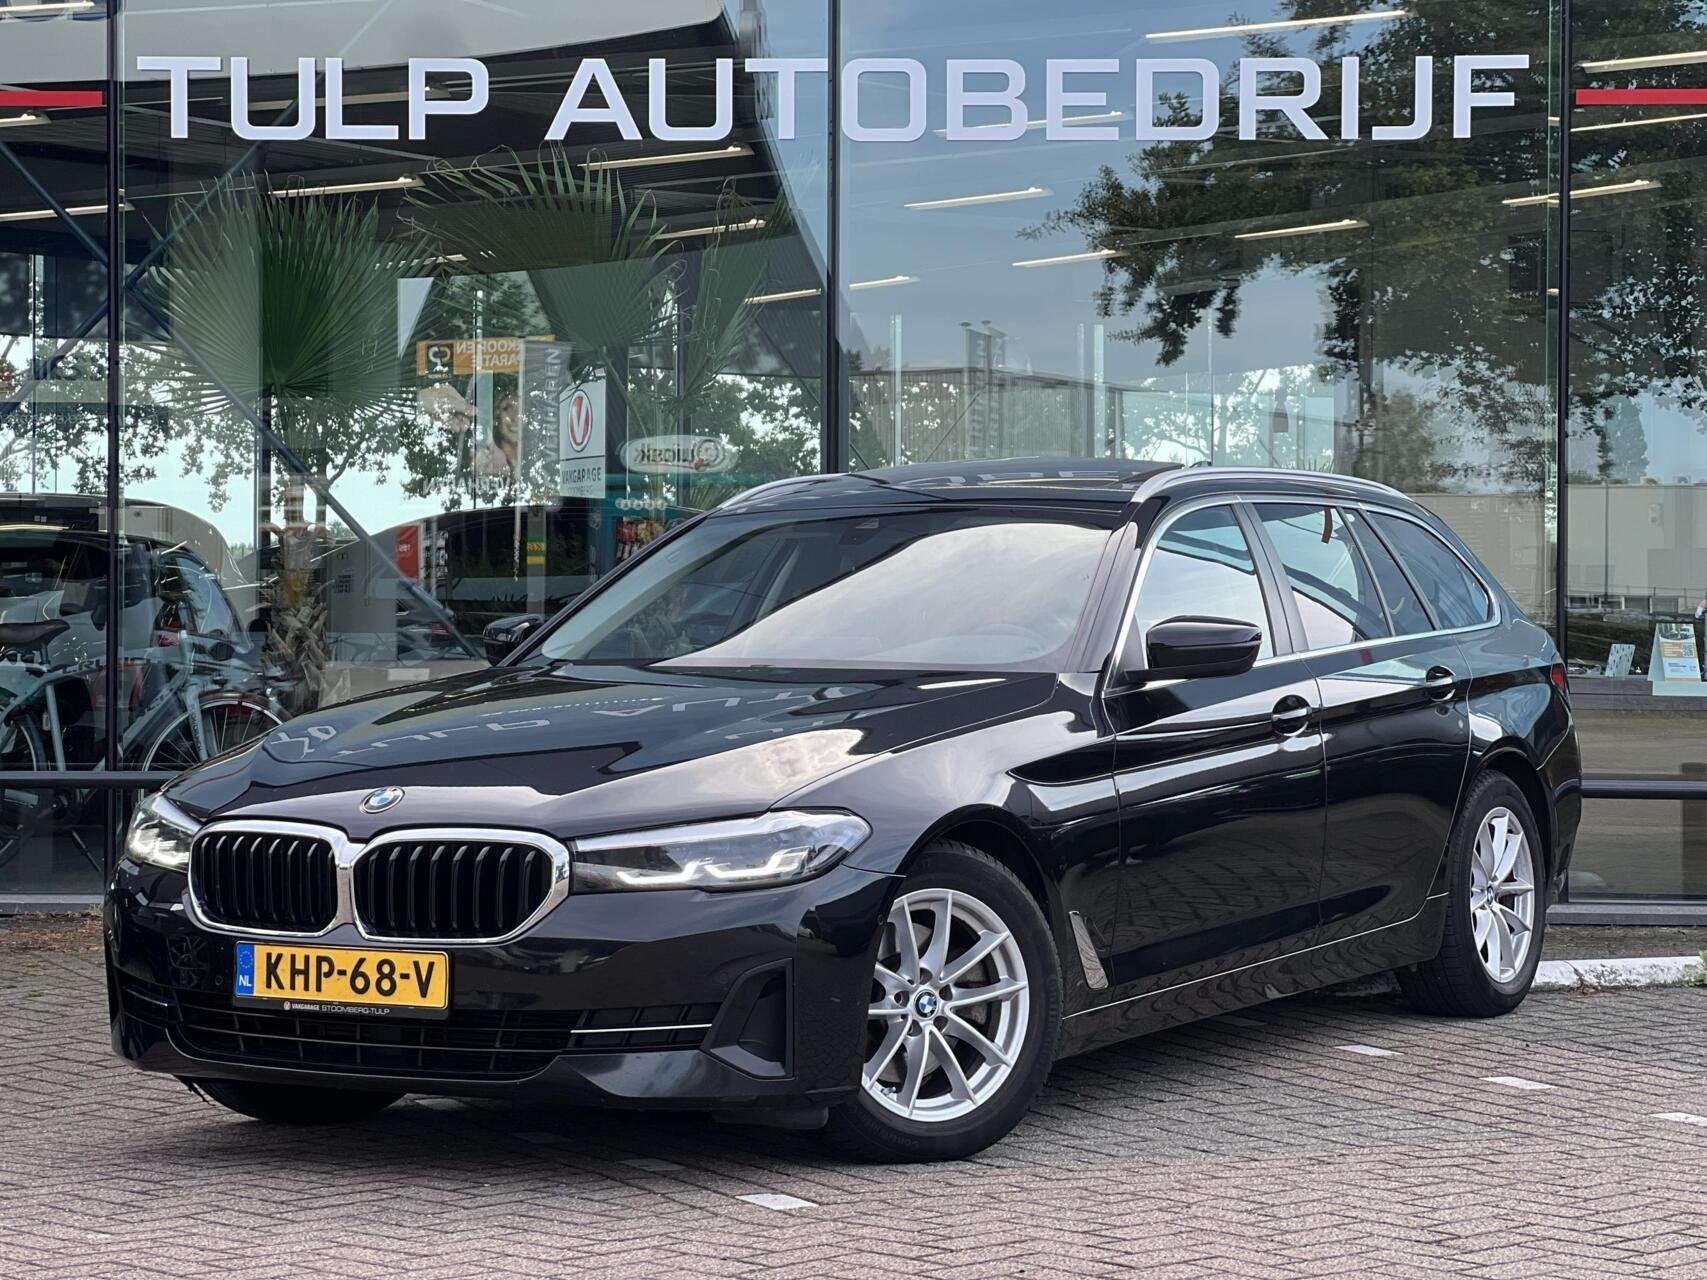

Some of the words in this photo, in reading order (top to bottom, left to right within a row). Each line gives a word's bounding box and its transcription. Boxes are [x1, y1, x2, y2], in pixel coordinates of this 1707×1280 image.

[137, 56, 489, 141] TULP
[543, 54, 1530, 142] AUTOBEDRIJF
[238, 975, 252, 987] NL
[265, 952, 435, 999] KHP-68-V
